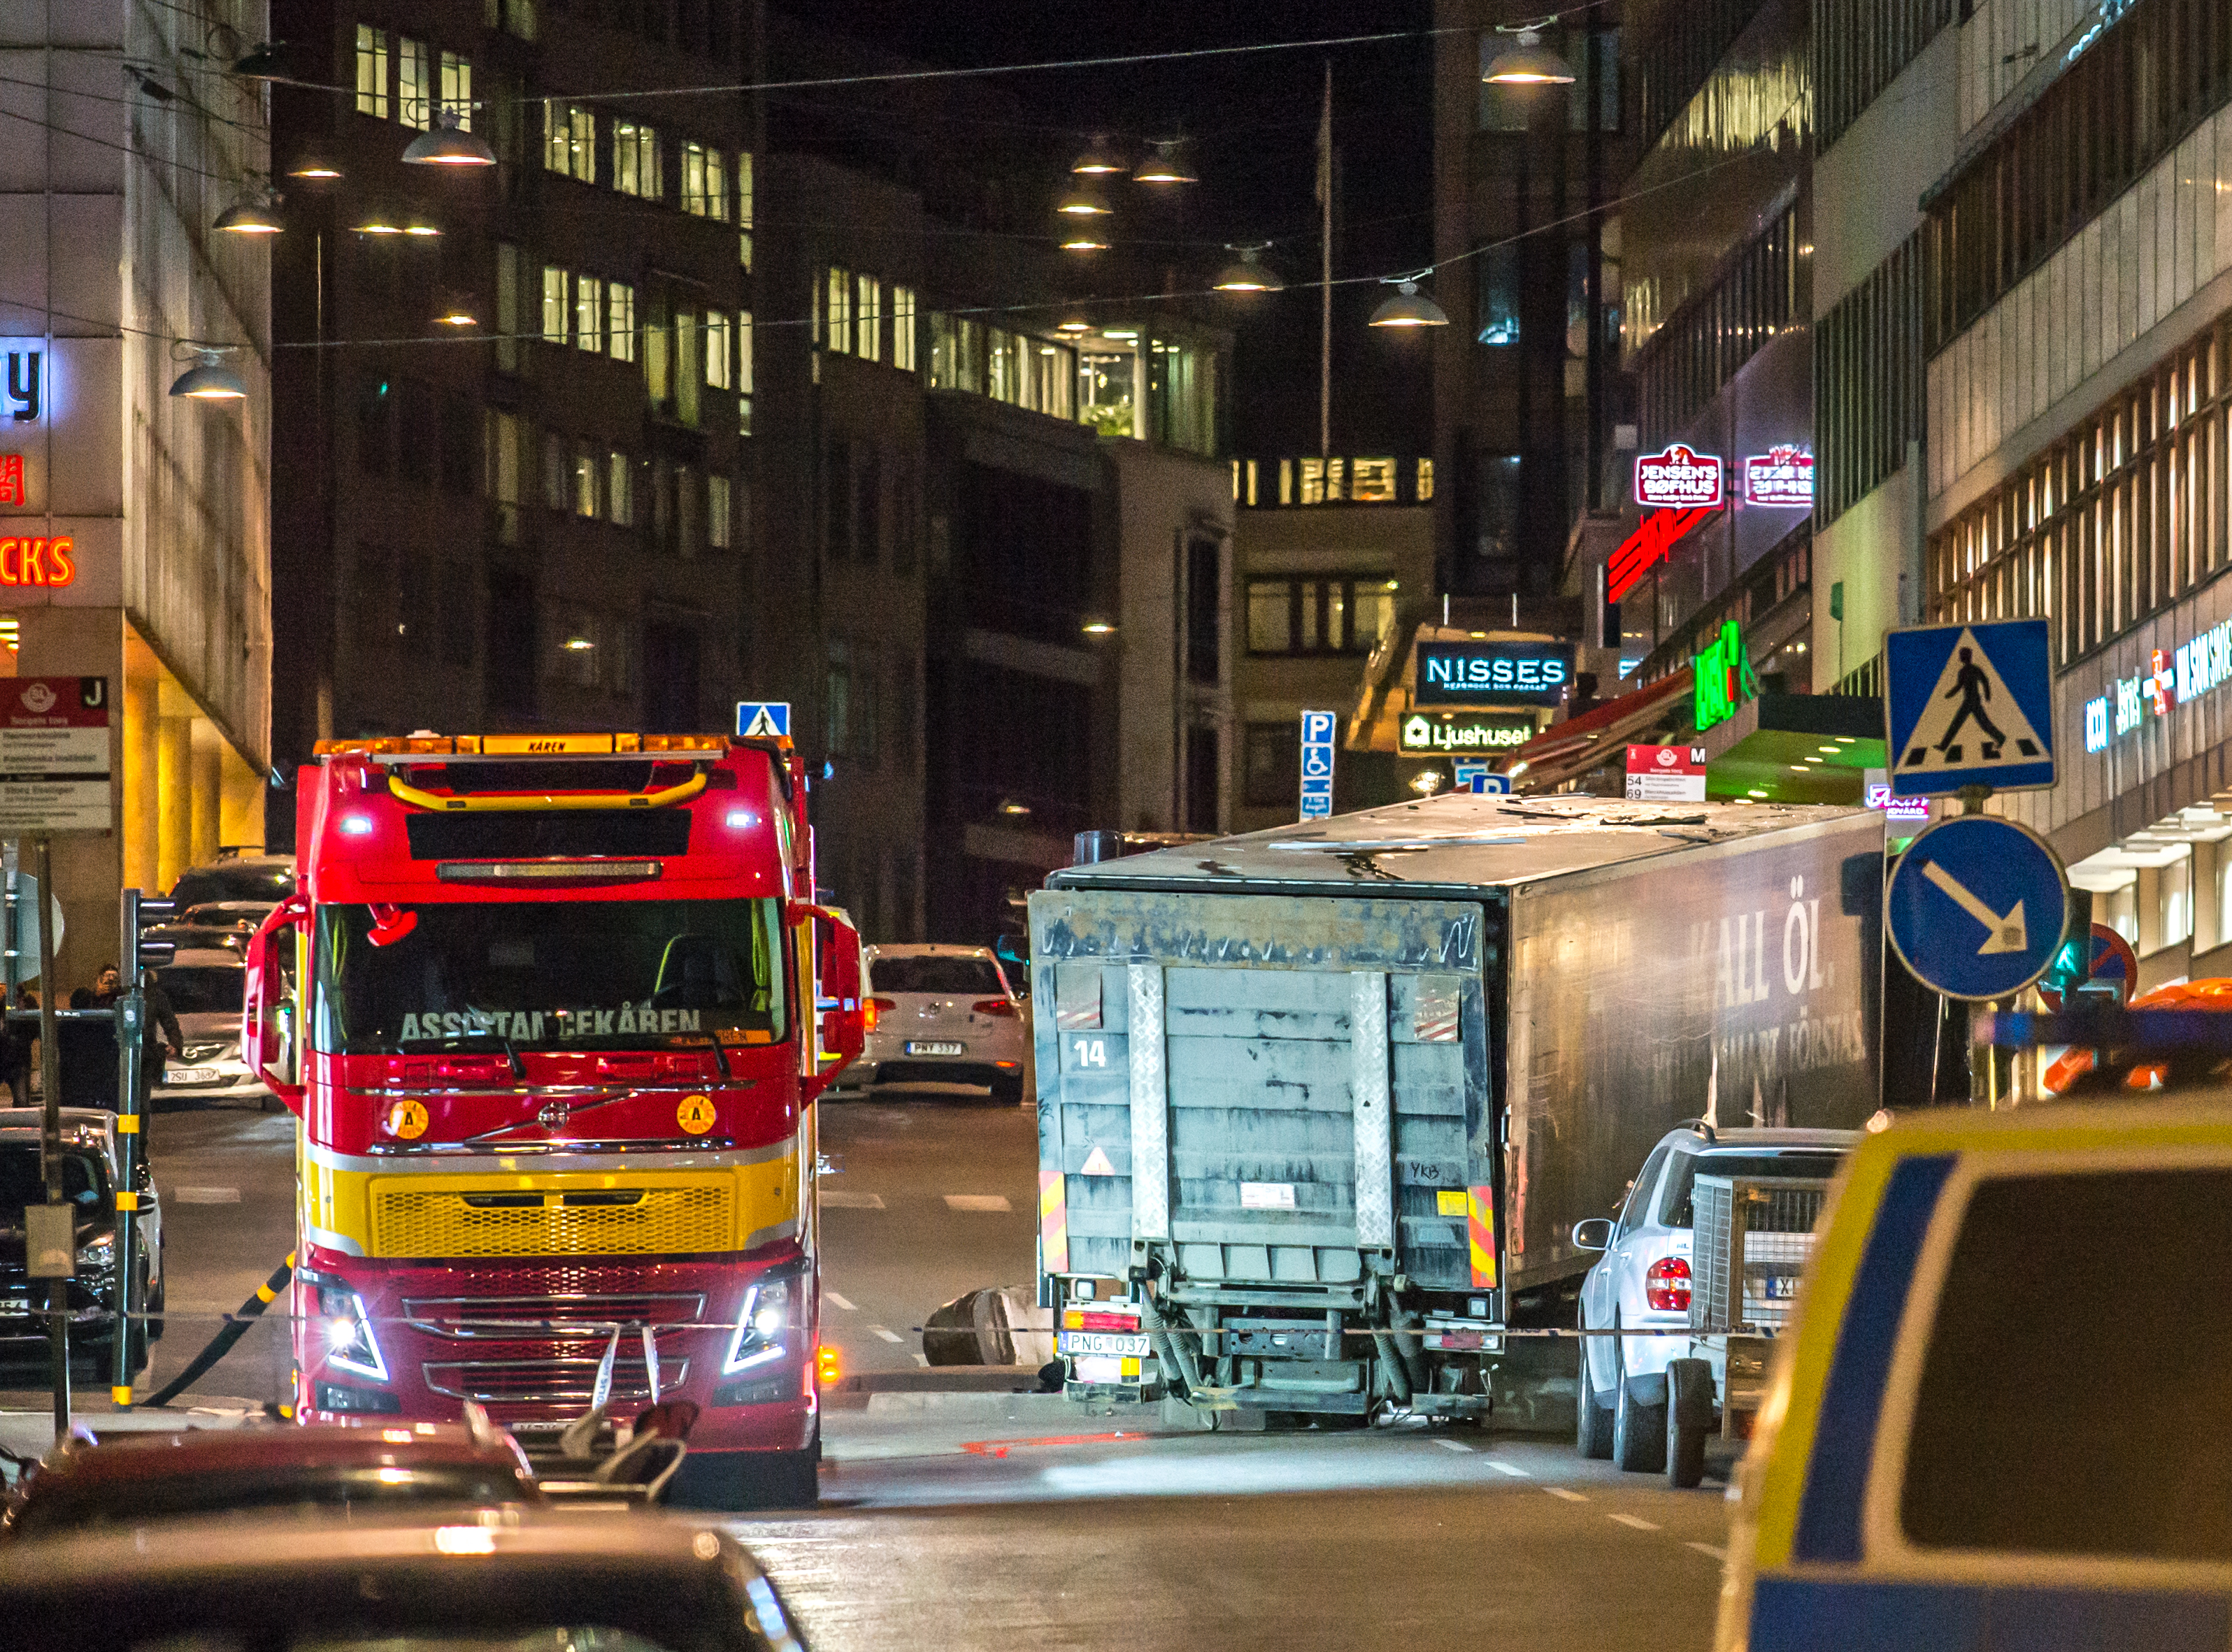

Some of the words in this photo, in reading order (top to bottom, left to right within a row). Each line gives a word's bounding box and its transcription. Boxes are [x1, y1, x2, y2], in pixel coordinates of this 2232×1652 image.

[1640, 466, 1717, 480] JENSEN'S
[1643, 480, 1715, 494] BØFHUS
[0, 537, 74, 587] CKS
[1427, 656, 1566, 684] NISSES
[85, 680, 102, 706] J
[1310, 715, 1329, 742] P
[1691, 748, 1705, 763] M
[1627, 776, 1642, 786] 54
[1626, 789, 1642, 799] 69
[1074, 1040, 1106, 1068] 14
[1071, 1335, 1102, 1351] PNG
[1115, 1337, 1147, 1353] 037
